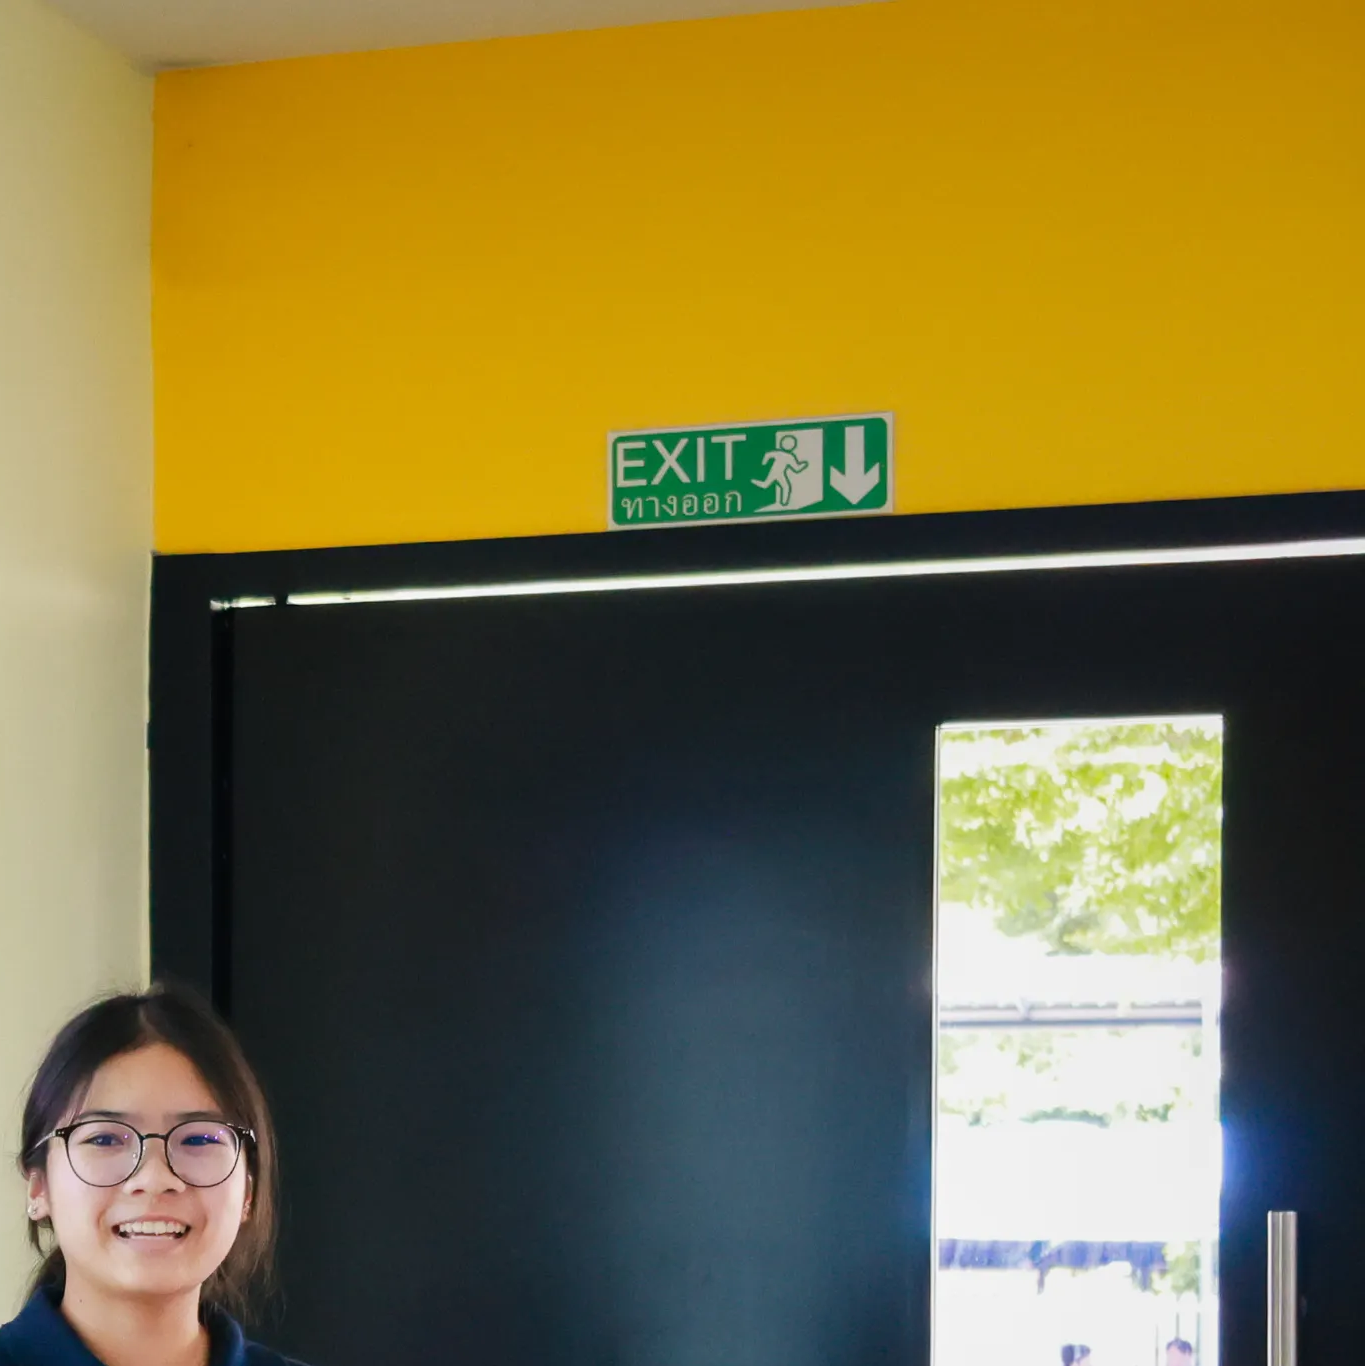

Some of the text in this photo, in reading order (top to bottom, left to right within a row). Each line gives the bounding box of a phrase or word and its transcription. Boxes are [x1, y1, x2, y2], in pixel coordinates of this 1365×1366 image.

[616, 434, 747, 488] EXIT
[622, 490, 742, 520] ทางออก
